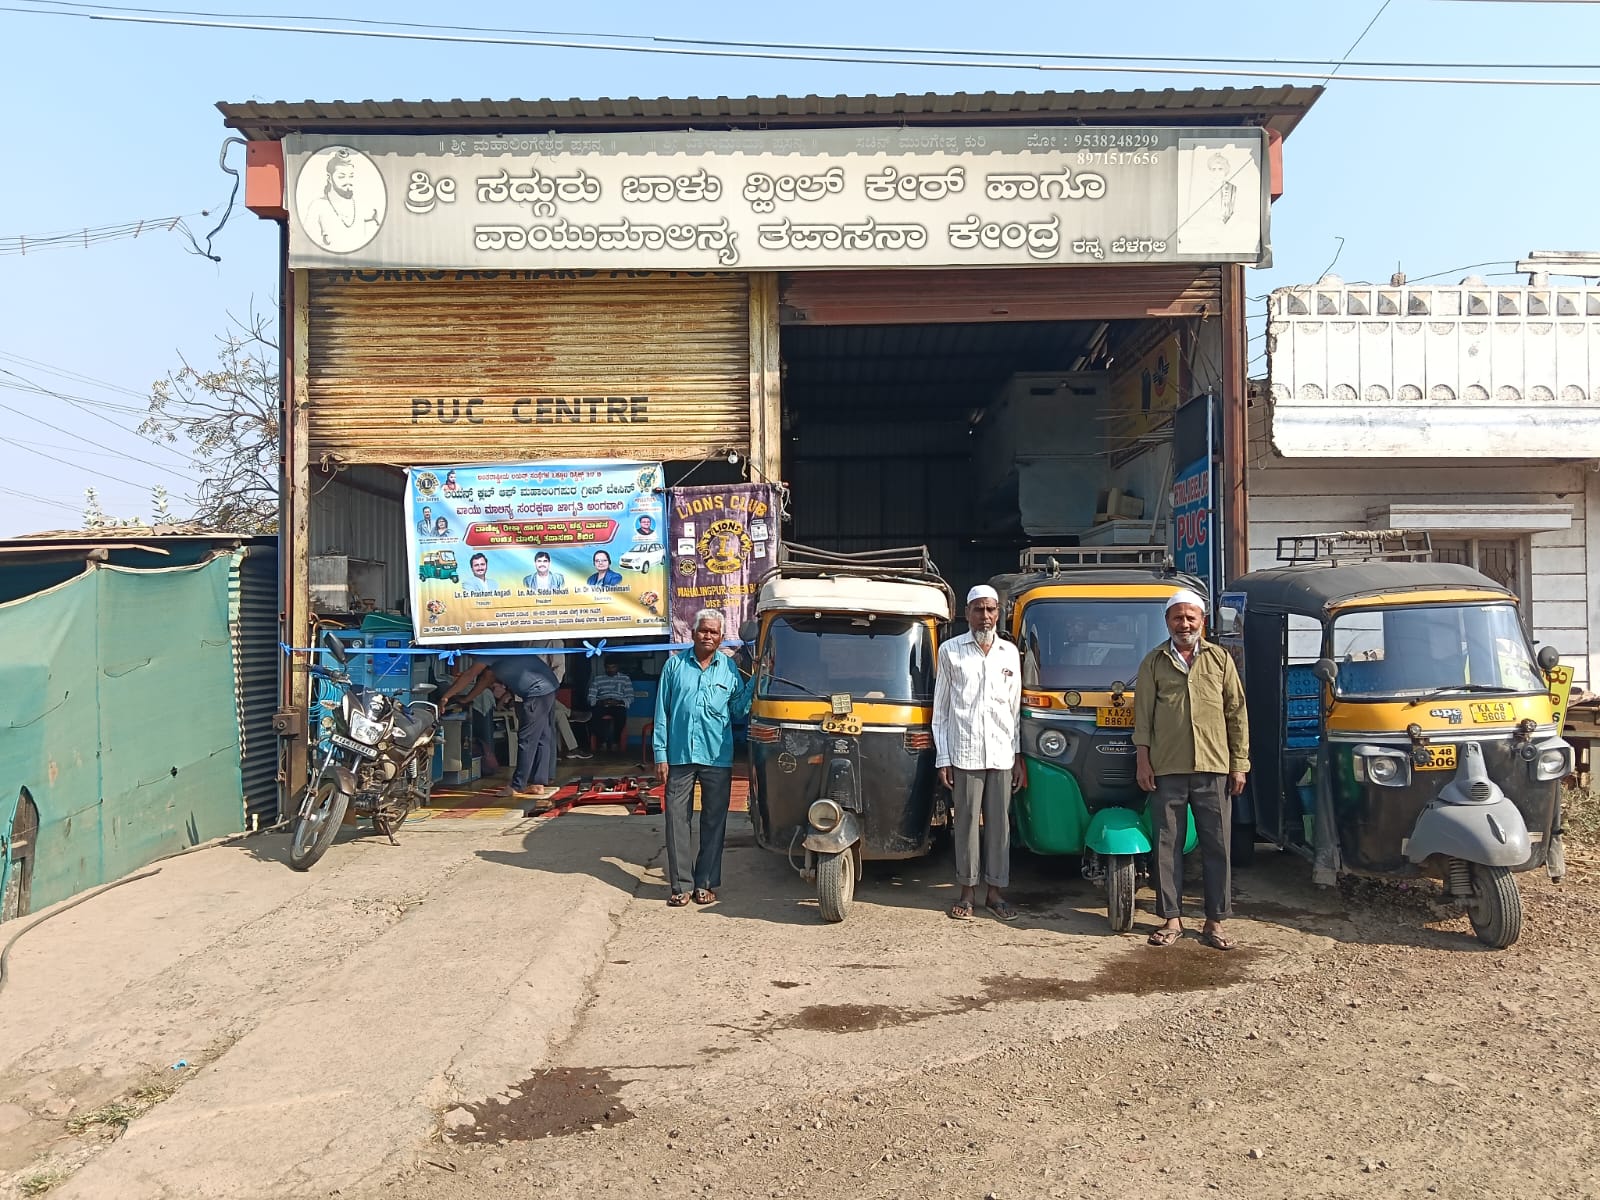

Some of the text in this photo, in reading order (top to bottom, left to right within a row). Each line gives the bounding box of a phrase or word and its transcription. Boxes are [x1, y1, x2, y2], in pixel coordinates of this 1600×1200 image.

[451, 139, 466, 155] ಶ್ರೀ
[1075, 134, 1159, 147] 9538248299
[1077, 152, 1159, 165] 8971517656
[405, 165, 1107, 218] ಶ್ರೀ ಸದ್ಗುರು ಬಾಳು ವ್ಹೀಲ್ ಕೇರ್ ಹಾಗೂ
[474, 215, 1167, 266] ವಾಯುಮಾಲಿನ್ಯ ತಪಾಸನಾ ಕೇಂದ್ರ ರನ್ನ ಬೆಳಗಲಿ
[410, 396, 649, 424] PUC CENTRE
[456, 504, 482, 515] ವಾಯು
[676, 495, 768, 520] LIONS CLUB
[712, 522, 740, 533] LIONS
[1177, 507, 1207, 551] PUC
[677, 584, 727, 598] MAHALINGPUR
[1108, 708, 1131, 716] KA29
[1477, 704, 1490, 712] KA
